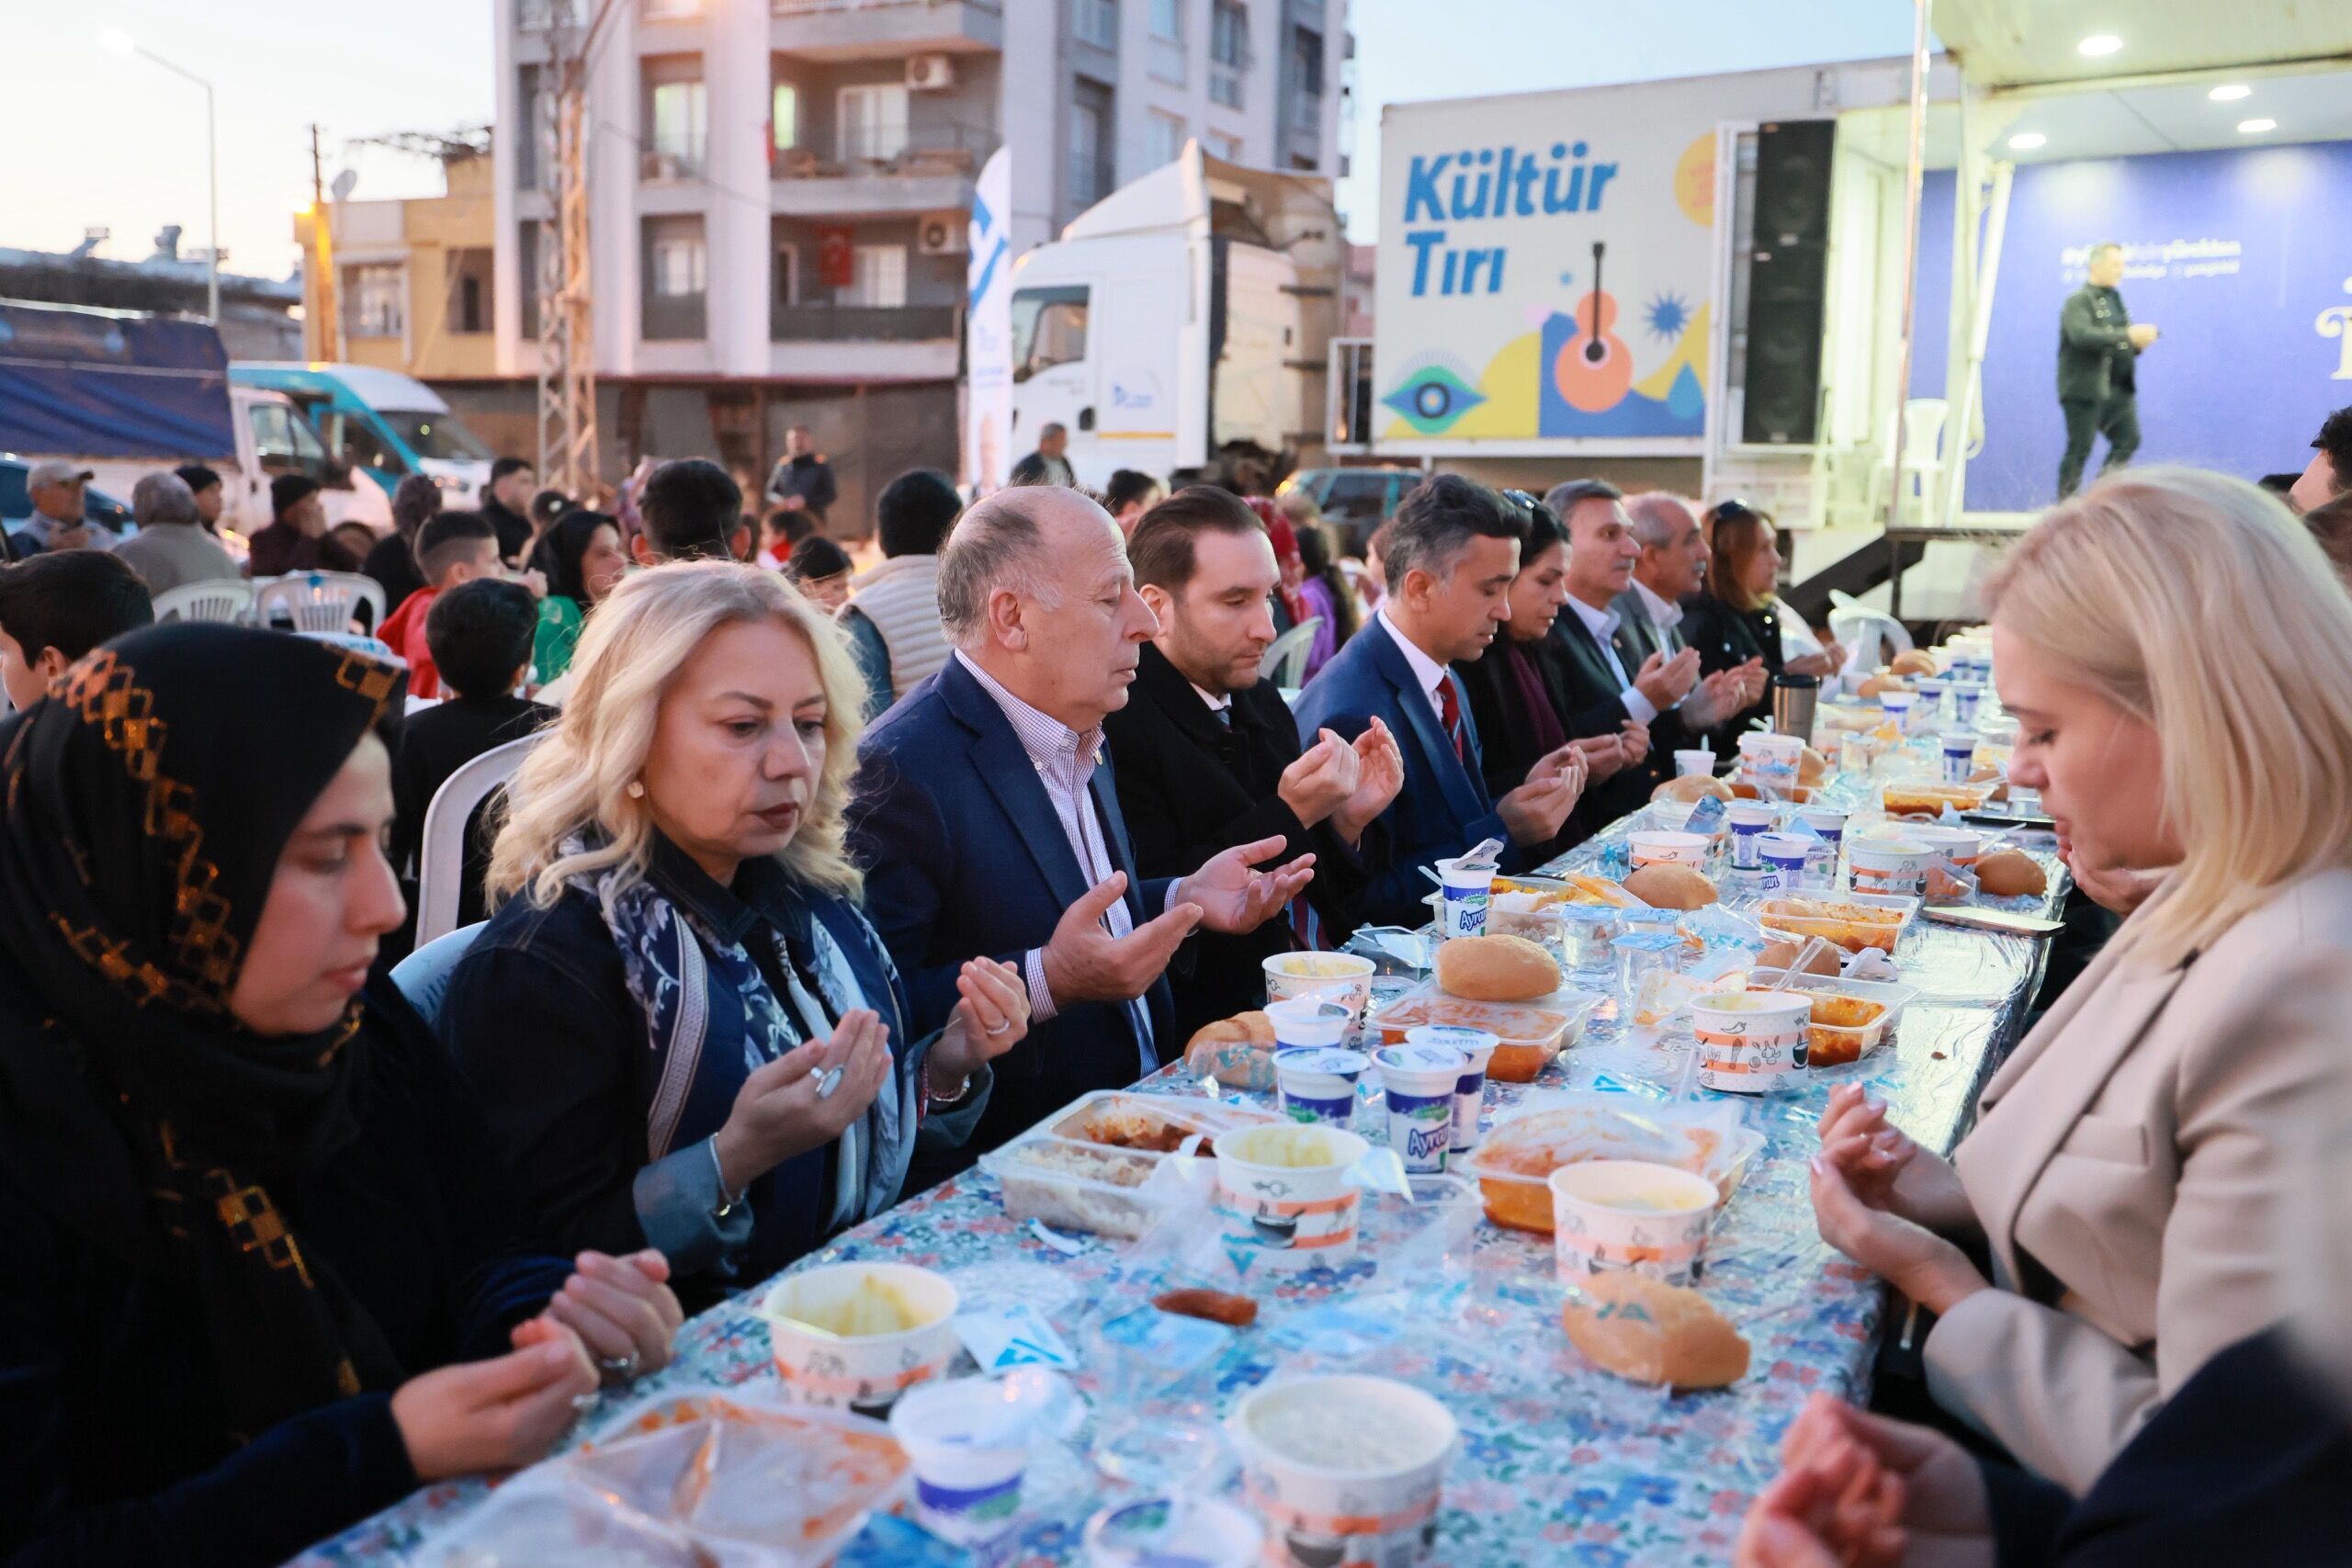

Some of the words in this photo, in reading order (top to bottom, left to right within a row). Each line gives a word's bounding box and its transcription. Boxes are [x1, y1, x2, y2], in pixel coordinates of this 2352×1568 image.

[1404, 141, 1618, 222] Kültür
[1405, 230, 1507, 297] Tırı
[1460, 906, 1487, 931] Ayra
